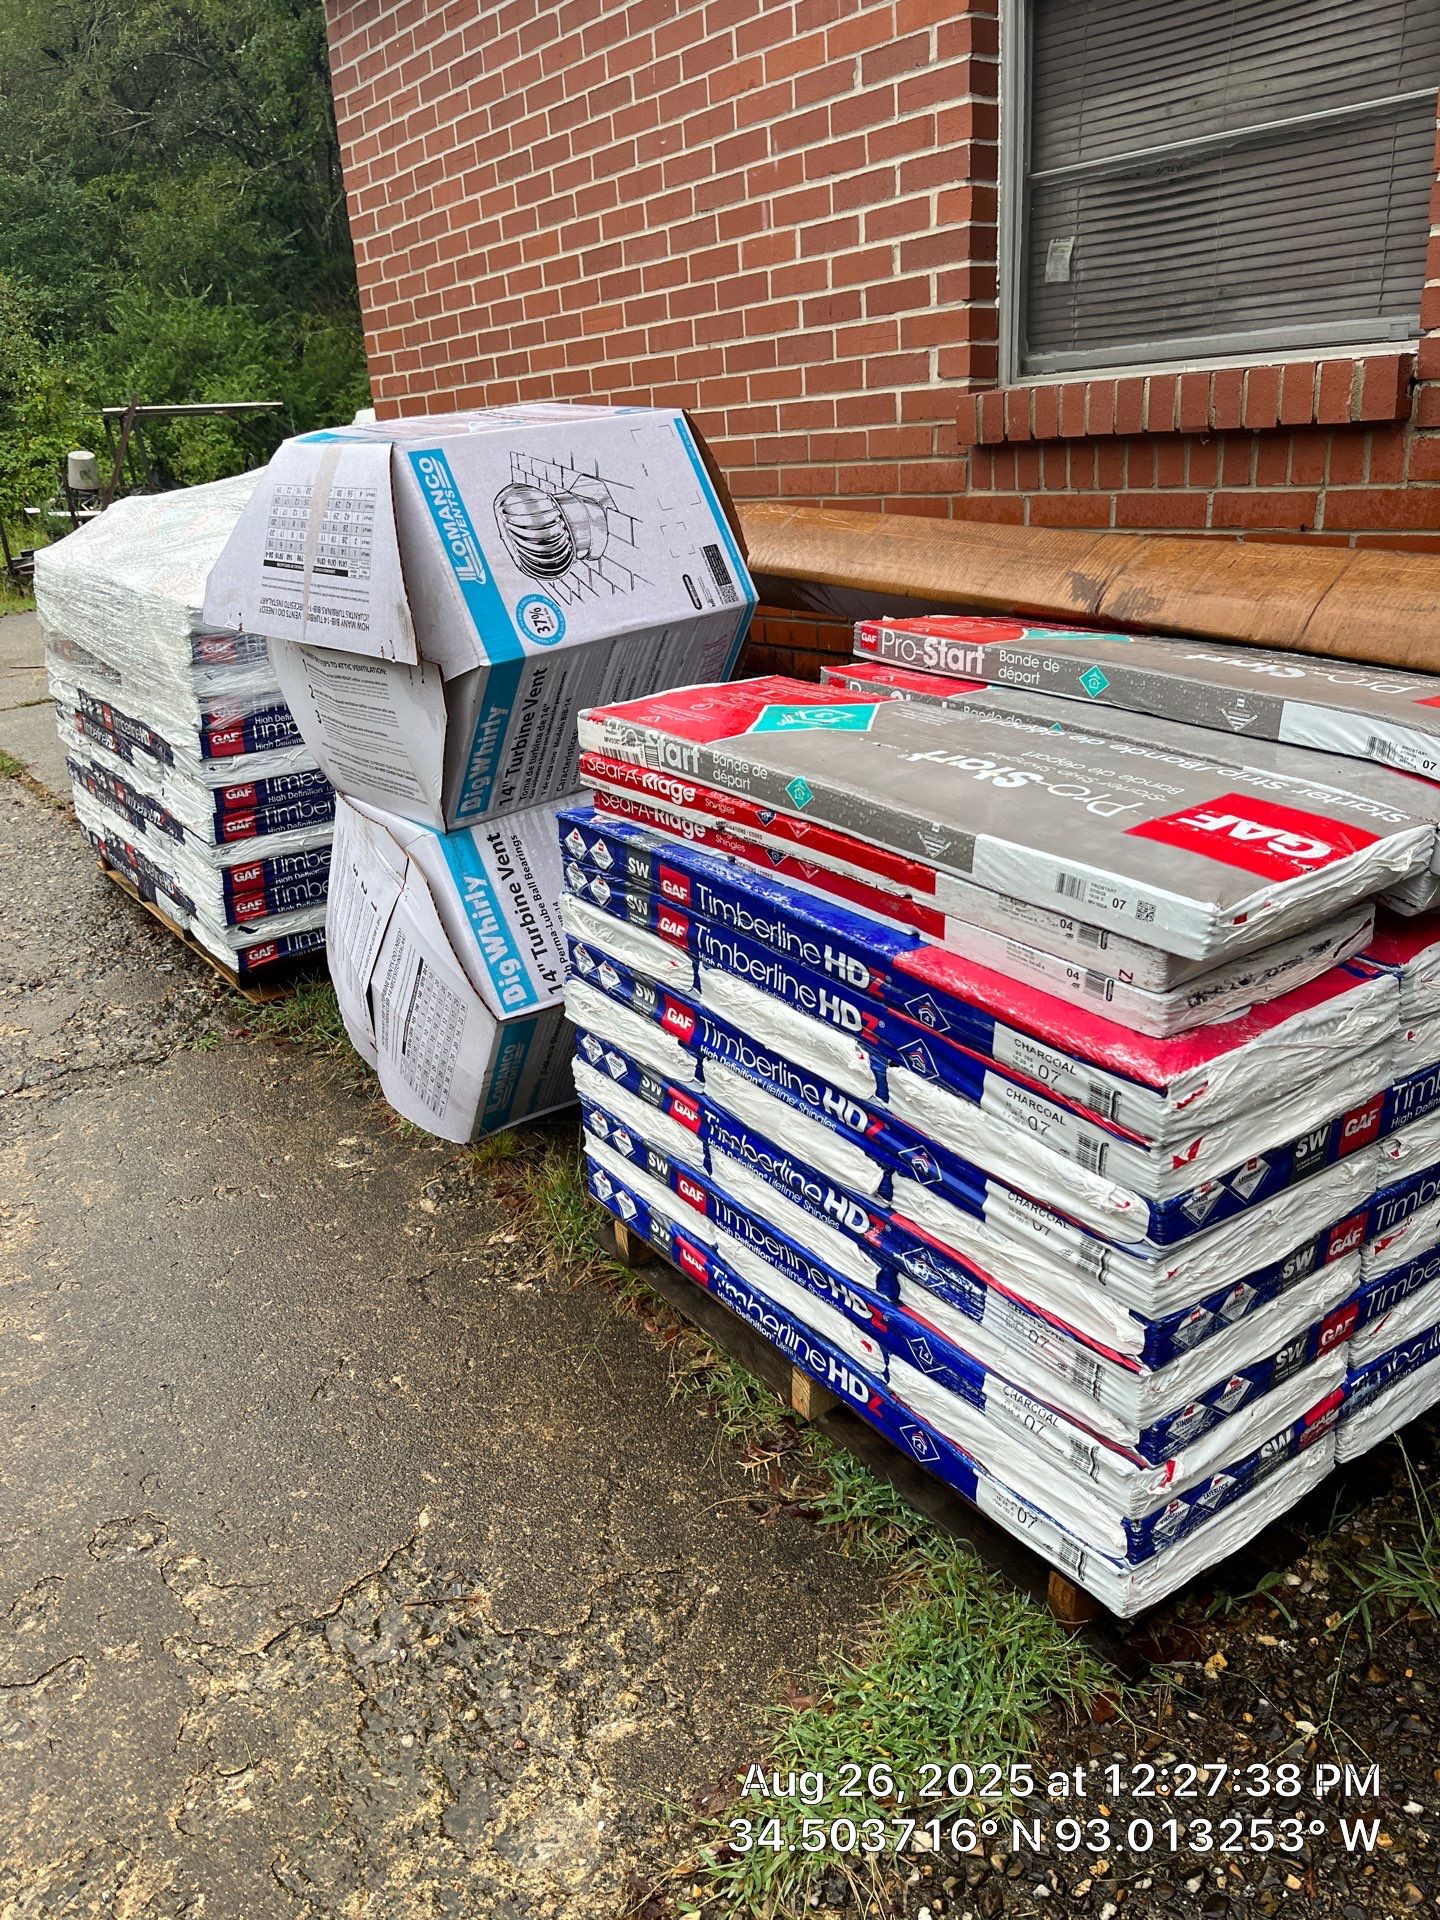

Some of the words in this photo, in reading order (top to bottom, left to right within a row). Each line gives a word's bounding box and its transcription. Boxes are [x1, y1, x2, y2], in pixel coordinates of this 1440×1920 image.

[419, 456, 478, 582] LOMANCO
[445, 489, 470, 537] VENTS
[356, 621, 369, 631] HOW
[529, 607, 551, 634] 37%
[861, 632, 878, 644] GAF
[881, 629, 985, 675] Pro-Start
[999, 649, 1040, 669] Bande
[1043, 658, 1060, 674] de
[998, 666, 1040, 685] départ
[506, 716, 533, 778] Turbine
[521, 666, 547, 711] Vent
[536, 718, 547, 731] de
[553, 721, 565, 748] Modelo
[212, 732, 240, 745] GAF
[528, 731, 544, 765] turbina
[1068, 733, 1106, 746] de
[524, 765, 534, 777] de
[712, 751, 749, 774] Bande
[752, 763, 768, 780] de
[1422, 760, 1438, 771] 07
[518, 776, 532, 801] Toma
[712, 768, 751, 791] départ
[1118, 774, 1186, 795] Bande
[1217, 769, 1291, 790] Strip
[225, 786, 253, 801] GAF
[268, 792, 287, 804] High
[1290, 789, 1411, 823] Starter
[704, 798, 736, 815] Shingles
[715, 833, 746, 853] Shingles
[1178, 807, 1332, 859] GAF
[486, 831, 515, 881] Vent
[510, 834, 533, 880] Bearings
[628, 856, 649, 880] SW
[234, 867, 261, 883] GAF
[528, 879, 542, 902] Ball
[662, 879, 688, 900] GAF
[626, 894, 648, 916] SW
[1112, 897, 1127, 911] 07
[509, 881, 548, 960] Turbine
[538, 901, 566, 964] Perma-Lube
[660, 917, 686, 939] GAF
[696, 883, 821, 965] Timberline
[1059, 918, 1074, 931] 04
[248, 944, 275, 961] GAF
[695, 922, 816, 1009] Timberline
[1066, 968, 1080, 981] 04
[635, 982, 656, 1006] SW
[667, 1007, 693, 1031] GAF
[700, 1016, 820, 1106] Timberline
[1014, 1038, 1077, 1076] CHARCOAL
[1038, 1063, 1062, 1085] 07
[700, 1044, 719, 1061] High
[798, 1102, 837, 1132] Shingles
[674, 1099, 700, 1123] GAF
[1006, 1087, 1066, 1127] CHARCOAL
[1390, 1106, 1414, 1129] High
[1027, 1115, 1051, 1136] 07
[1344, 1108, 1380, 1137] GAF
[1295, 1125, 1330, 1159] SW
[648, 1150, 669, 1177] SW
[704, 1110, 822, 1205] Timberline
[679, 1178, 706, 1204] GAF
[803, 1200, 840, 1230] Shingles
[1007, 1191, 1070, 1231] CHARCOAL
[651, 1217, 671, 1243] SW
[716, 1218, 734, 1237] High
[709, 1192, 828, 1290] Timberline
[1329, 1225, 1363, 1257] GAF
[1282, 1244, 1316, 1281] SW
[717, 1289, 735, 1309] High
[1028, 1328, 1050, 1349] 07
[1320, 1315, 1355, 1348] GAF
[1274, 1335, 1308, 1373] SW
[1002, 1385, 1060, 1428] CHARCOAL
[1023, 1413, 1047, 1435] 07
[1260, 1427, 1293, 1461] SW
[1203, 1480, 1231, 1500] LAYERLOCK
[1016, 1505, 1039, 1529] 07
